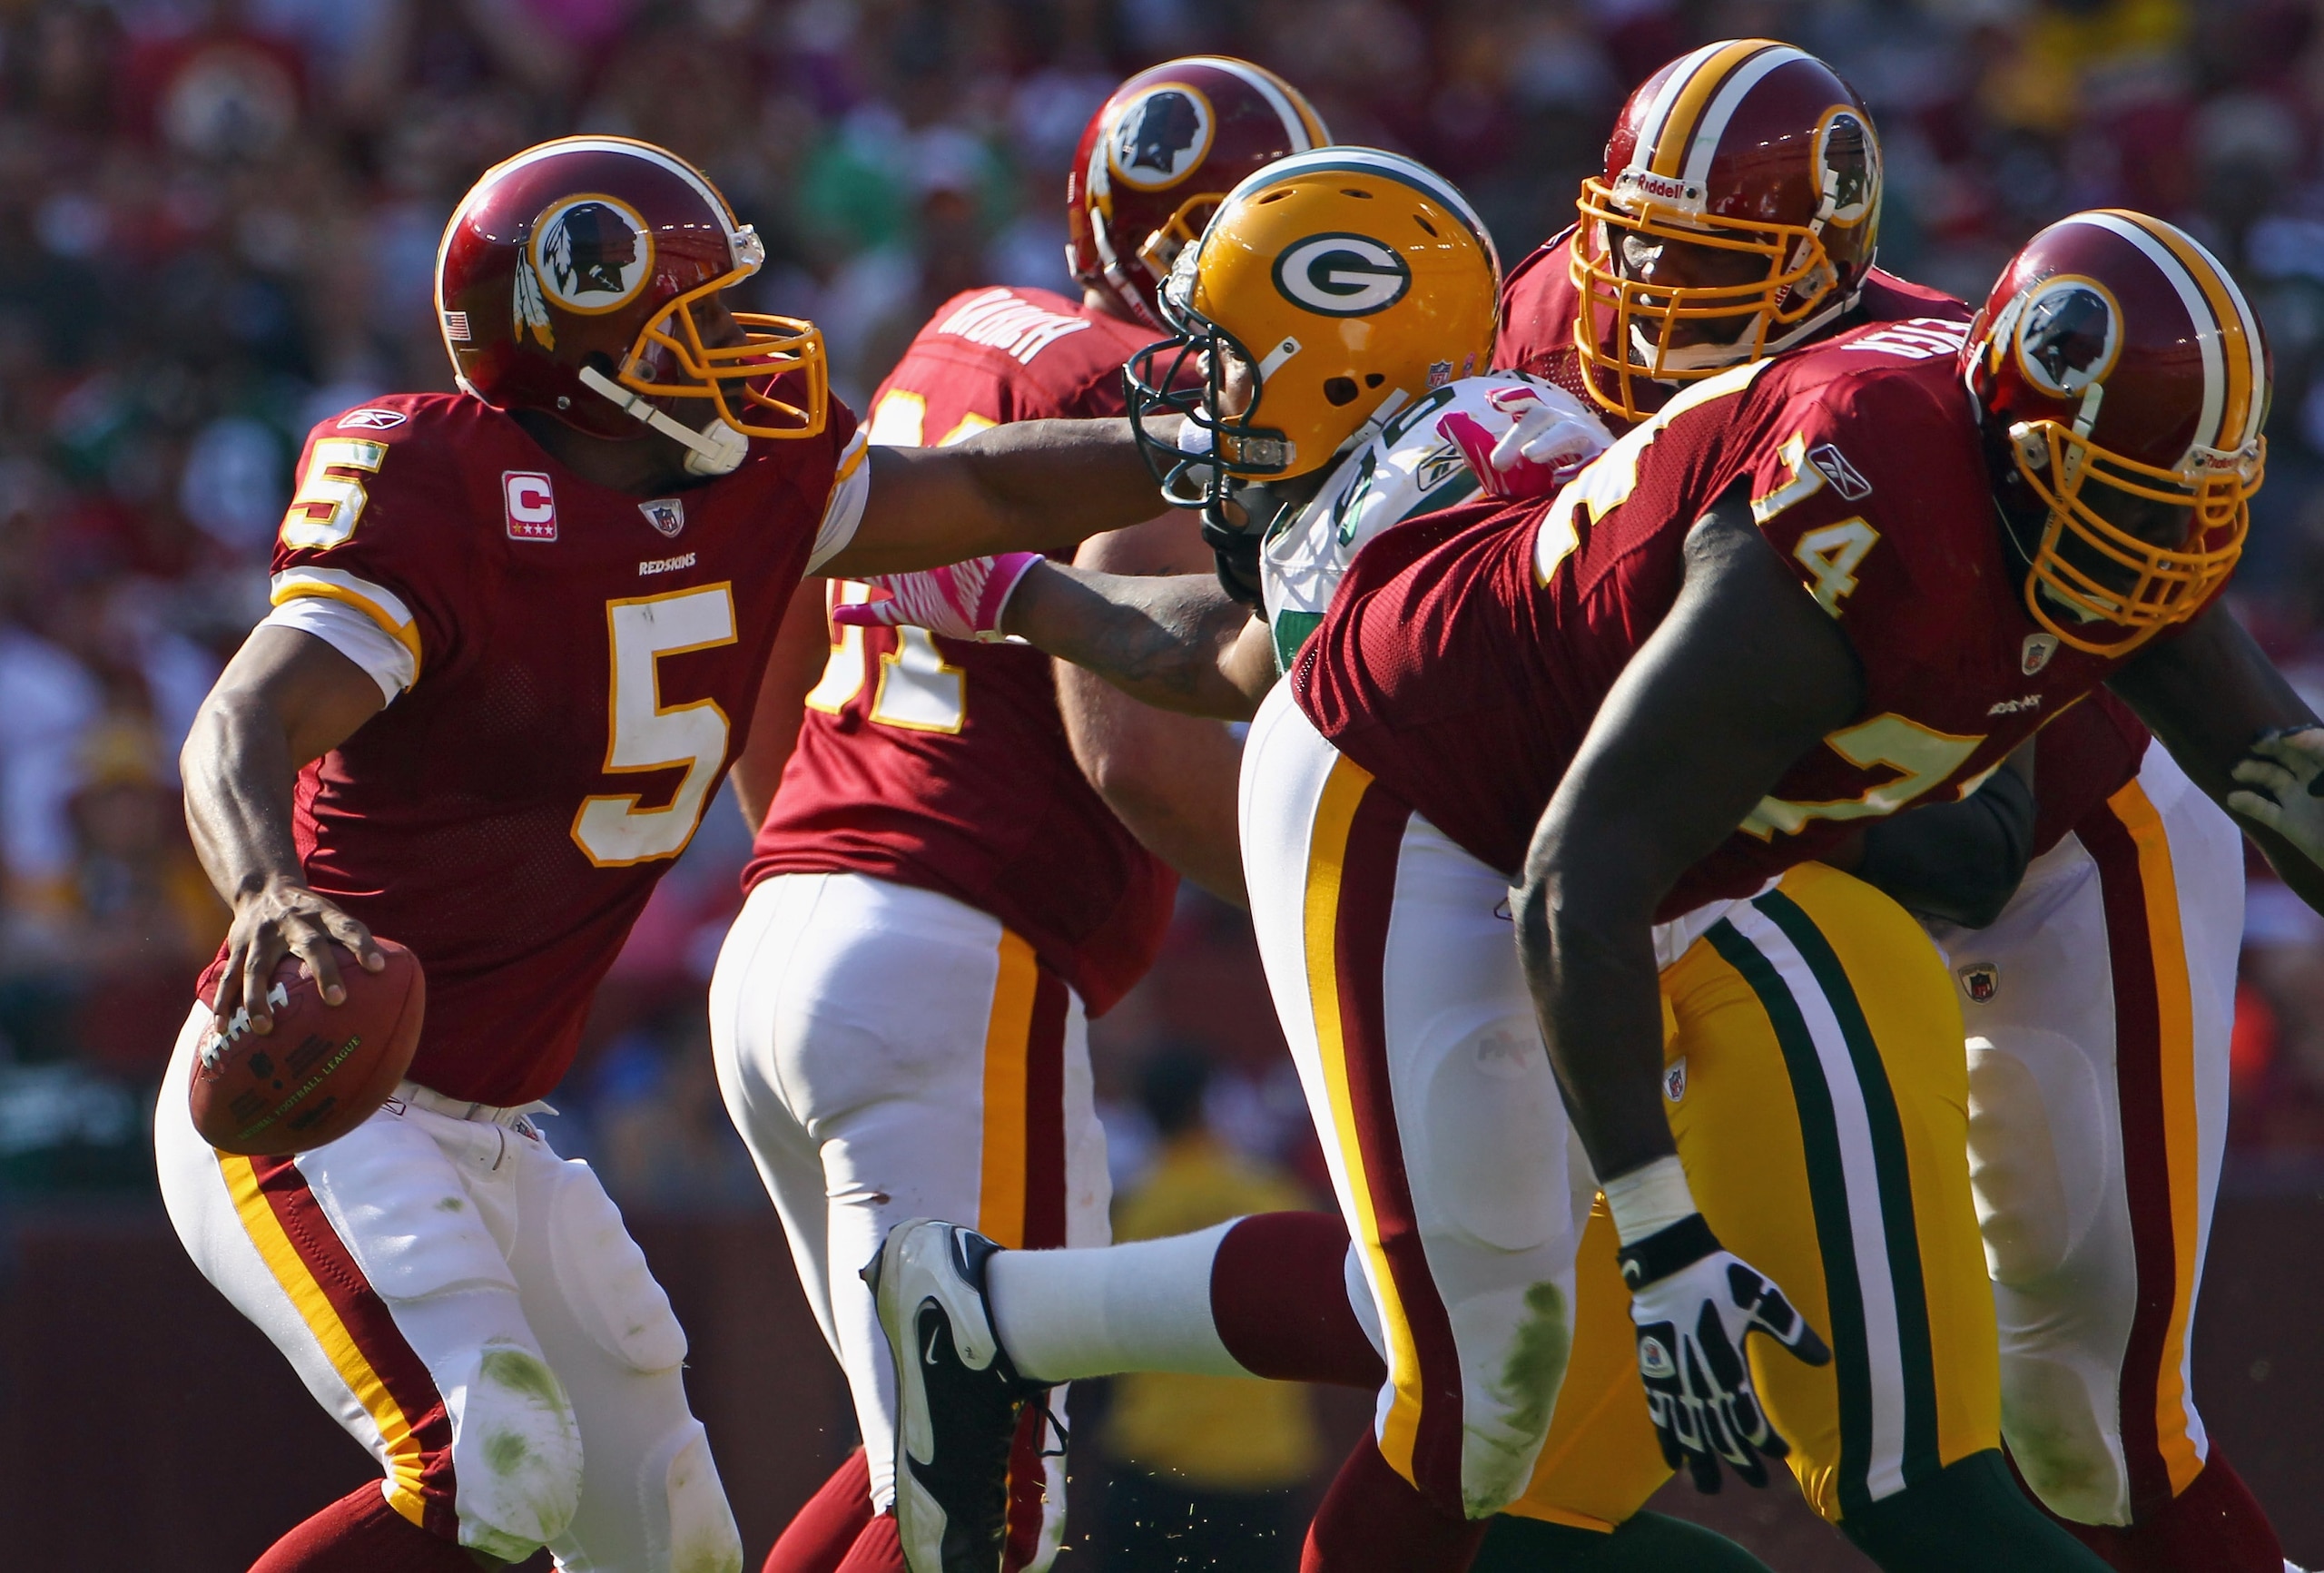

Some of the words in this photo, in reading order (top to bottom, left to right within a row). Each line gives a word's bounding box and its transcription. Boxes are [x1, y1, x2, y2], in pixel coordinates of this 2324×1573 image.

[1637, 173, 1686, 199] Riddell
[1280, 237, 1405, 312] G
[281, 437, 389, 551] 5
[507, 477, 553, 523] C
[1750, 430, 1881, 620] 74
[638, 552, 696, 576] REDSKINS
[570, 580, 739, 868] 5
[1738, 712, 2008, 844] 7
[275, 1076, 322, 1116] FOOTBALL
[322, 1036, 361, 1075] LEAGUE
